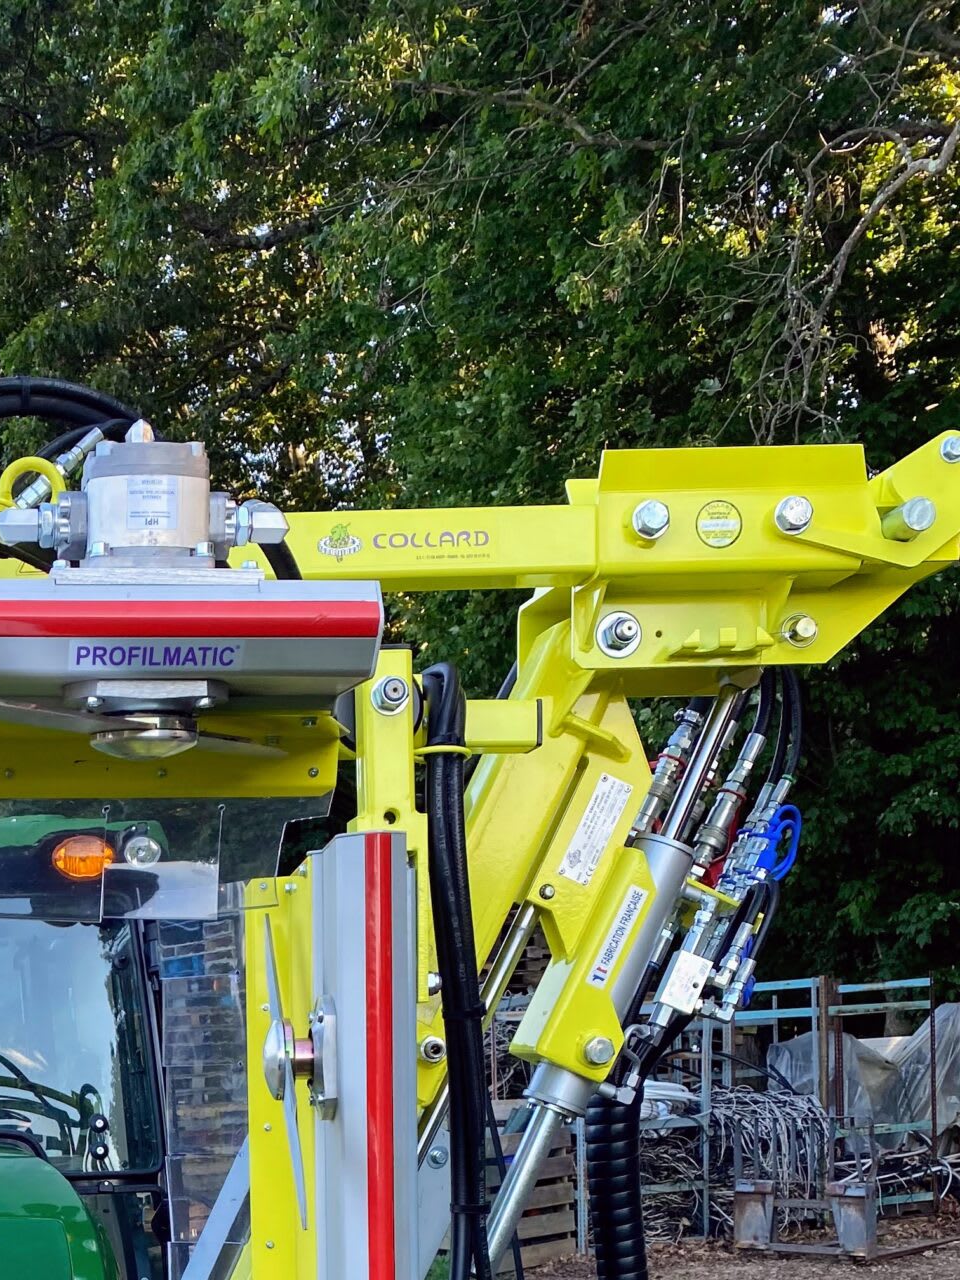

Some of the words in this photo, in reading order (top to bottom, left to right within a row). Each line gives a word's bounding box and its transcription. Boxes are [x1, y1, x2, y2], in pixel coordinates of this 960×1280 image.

[373, 530, 490, 549] COLLARD
[76, 645, 236, 666] PROFILMATIC
[601, 925, 626, 966] FABRICATION
